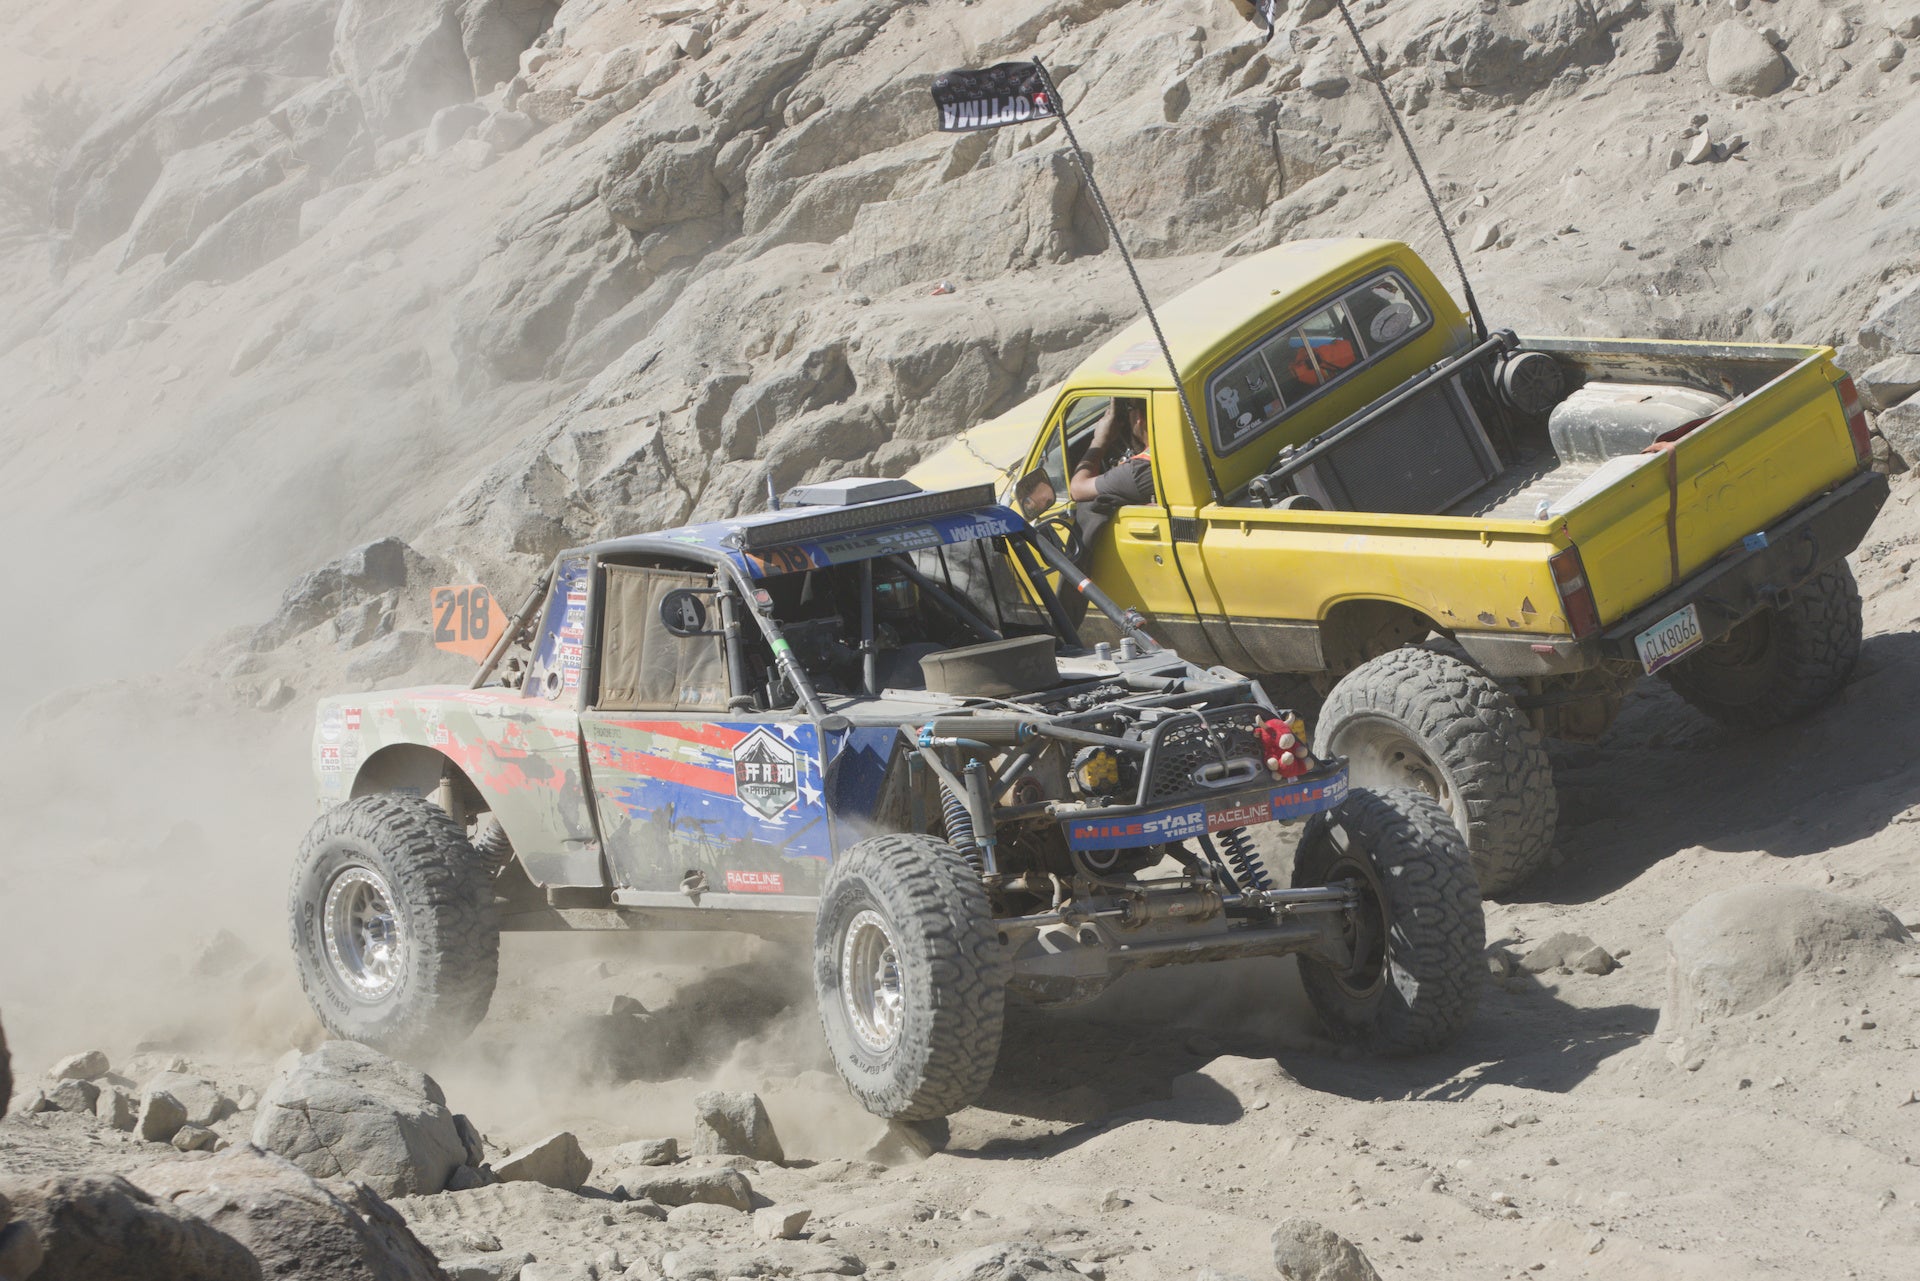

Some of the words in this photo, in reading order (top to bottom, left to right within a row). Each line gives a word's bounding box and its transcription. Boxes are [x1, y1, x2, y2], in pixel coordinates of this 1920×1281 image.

[944, 96, 1030, 129] OPTIMA
[900, 536, 940, 547] TIRES
[435, 588, 490, 642] 218
[1645, 615, 1697, 662] CLK8066
[737, 761, 760, 782] OFF
[763, 763, 793, 784] ROAD
[750, 786, 783, 796] PATRIOT
[1074, 811, 1203, 839] MILESTAR
[1208, 804, 1270, 826] RACELINE
[1164, 824, 1204, 838] TIRES
[727, 872, 781, 885] RACELINE
